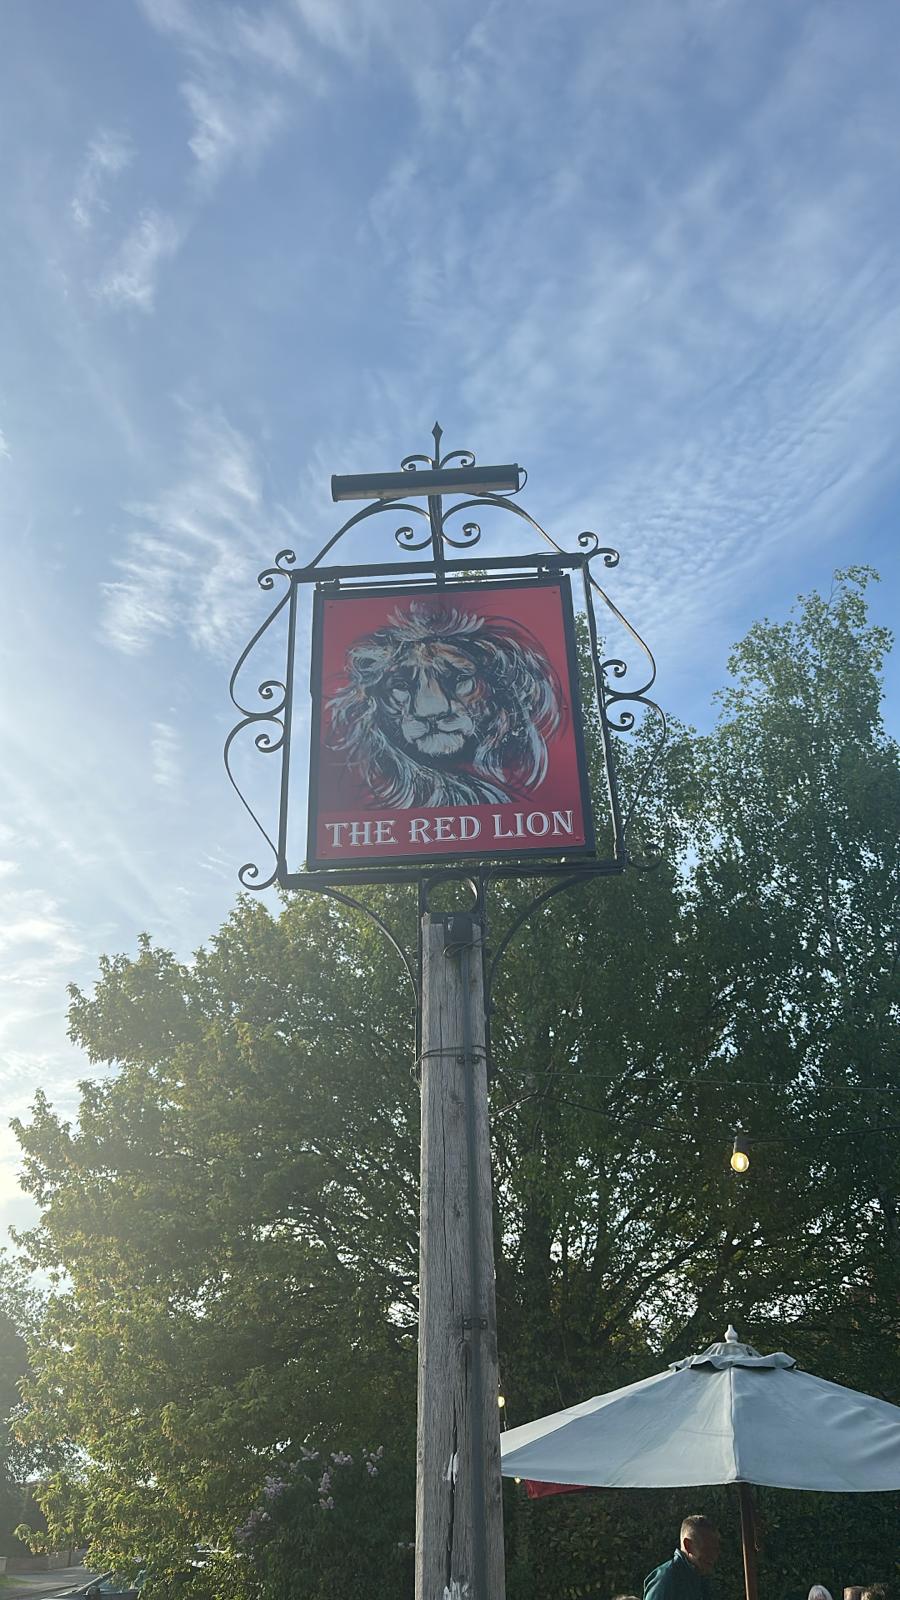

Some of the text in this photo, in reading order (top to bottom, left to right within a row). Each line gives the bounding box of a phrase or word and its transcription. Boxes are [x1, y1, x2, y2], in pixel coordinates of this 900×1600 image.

[324, 810, 574, 848] THE RED LION
